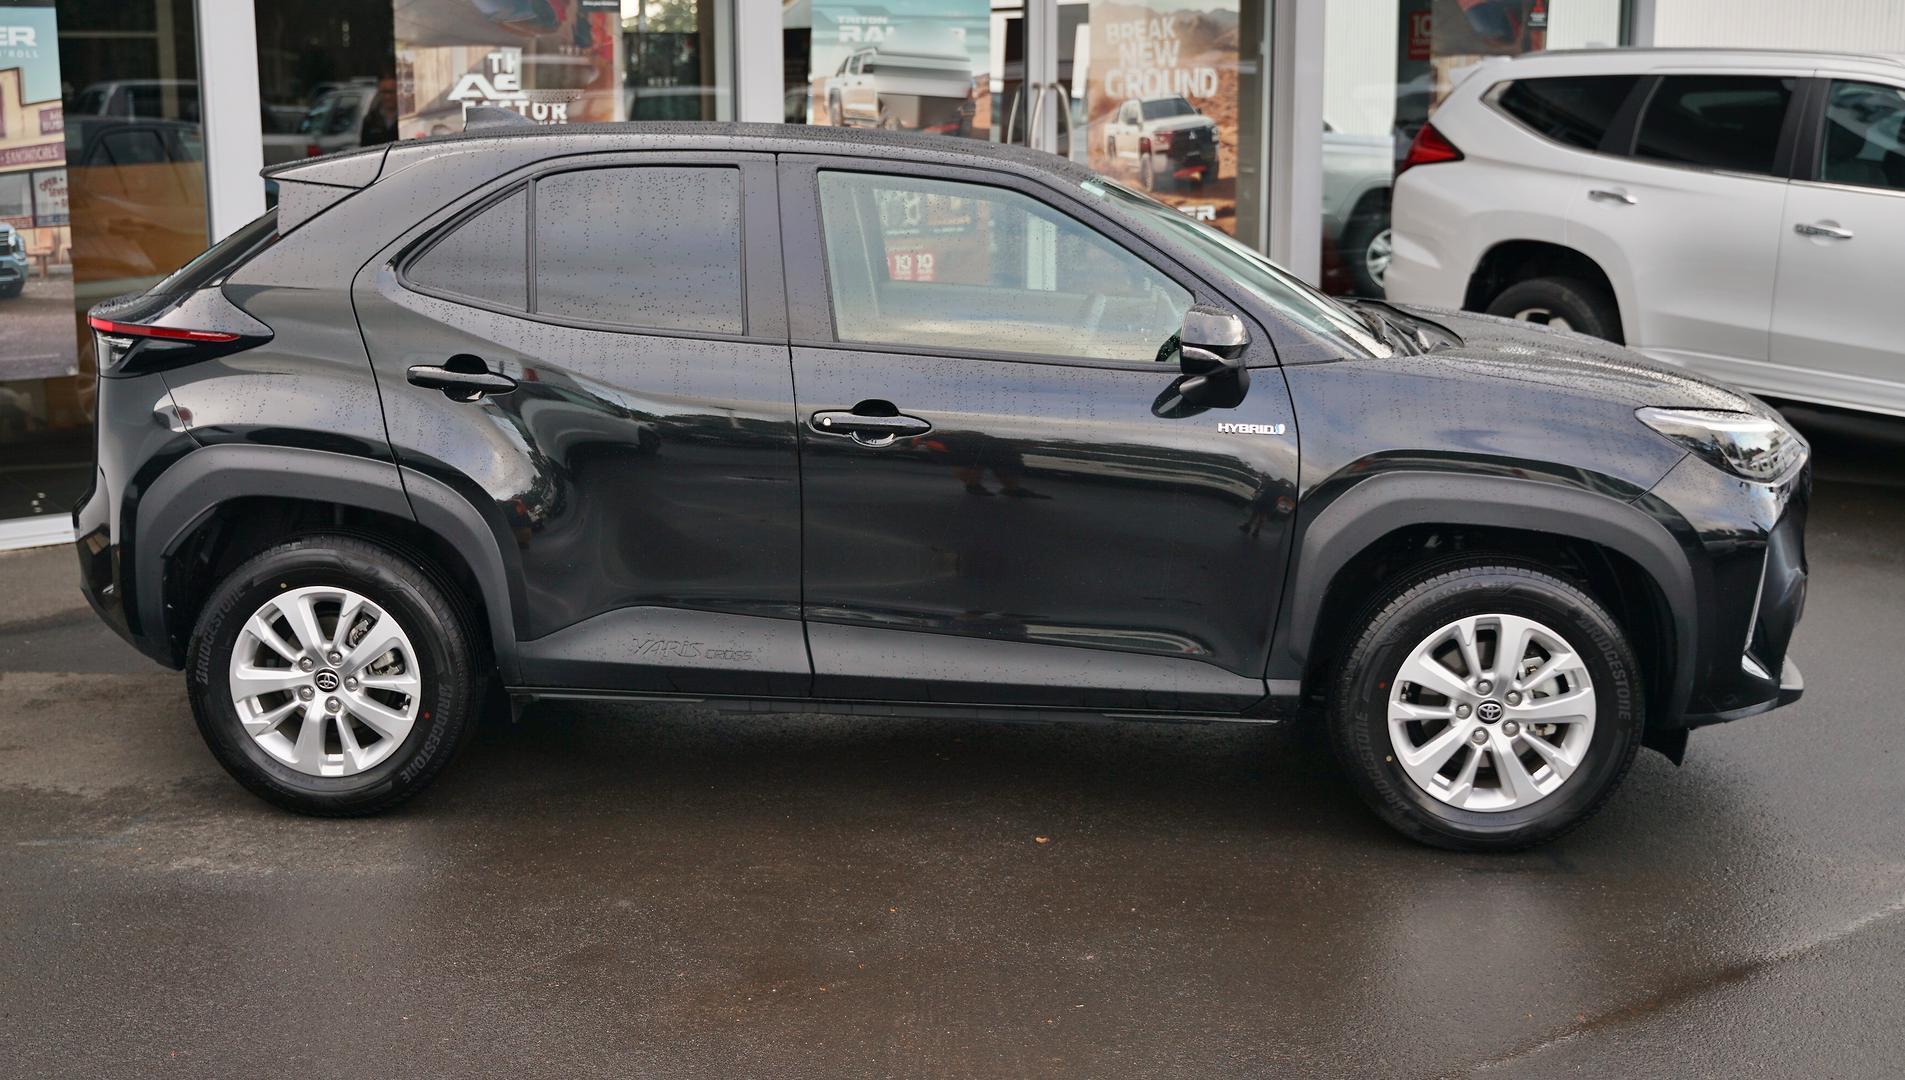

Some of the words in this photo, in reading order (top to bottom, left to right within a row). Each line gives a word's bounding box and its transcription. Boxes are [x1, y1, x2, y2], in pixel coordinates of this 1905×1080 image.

[837, 16, 888, 24] TRITON
[1106, 17, 1176, 45] BREAK
[1120, 38, 1181, 68] NEW
[1105, 67, 1218, 98] GROUND
[1217, 422, 1275, 434] HYBRID
[196, 586, 246, 686] BRIDGESTONE
[1573, 615, 1632, 721] BRIDGESTONE
[400, 682, 454, 784] BRIDGESTONE
